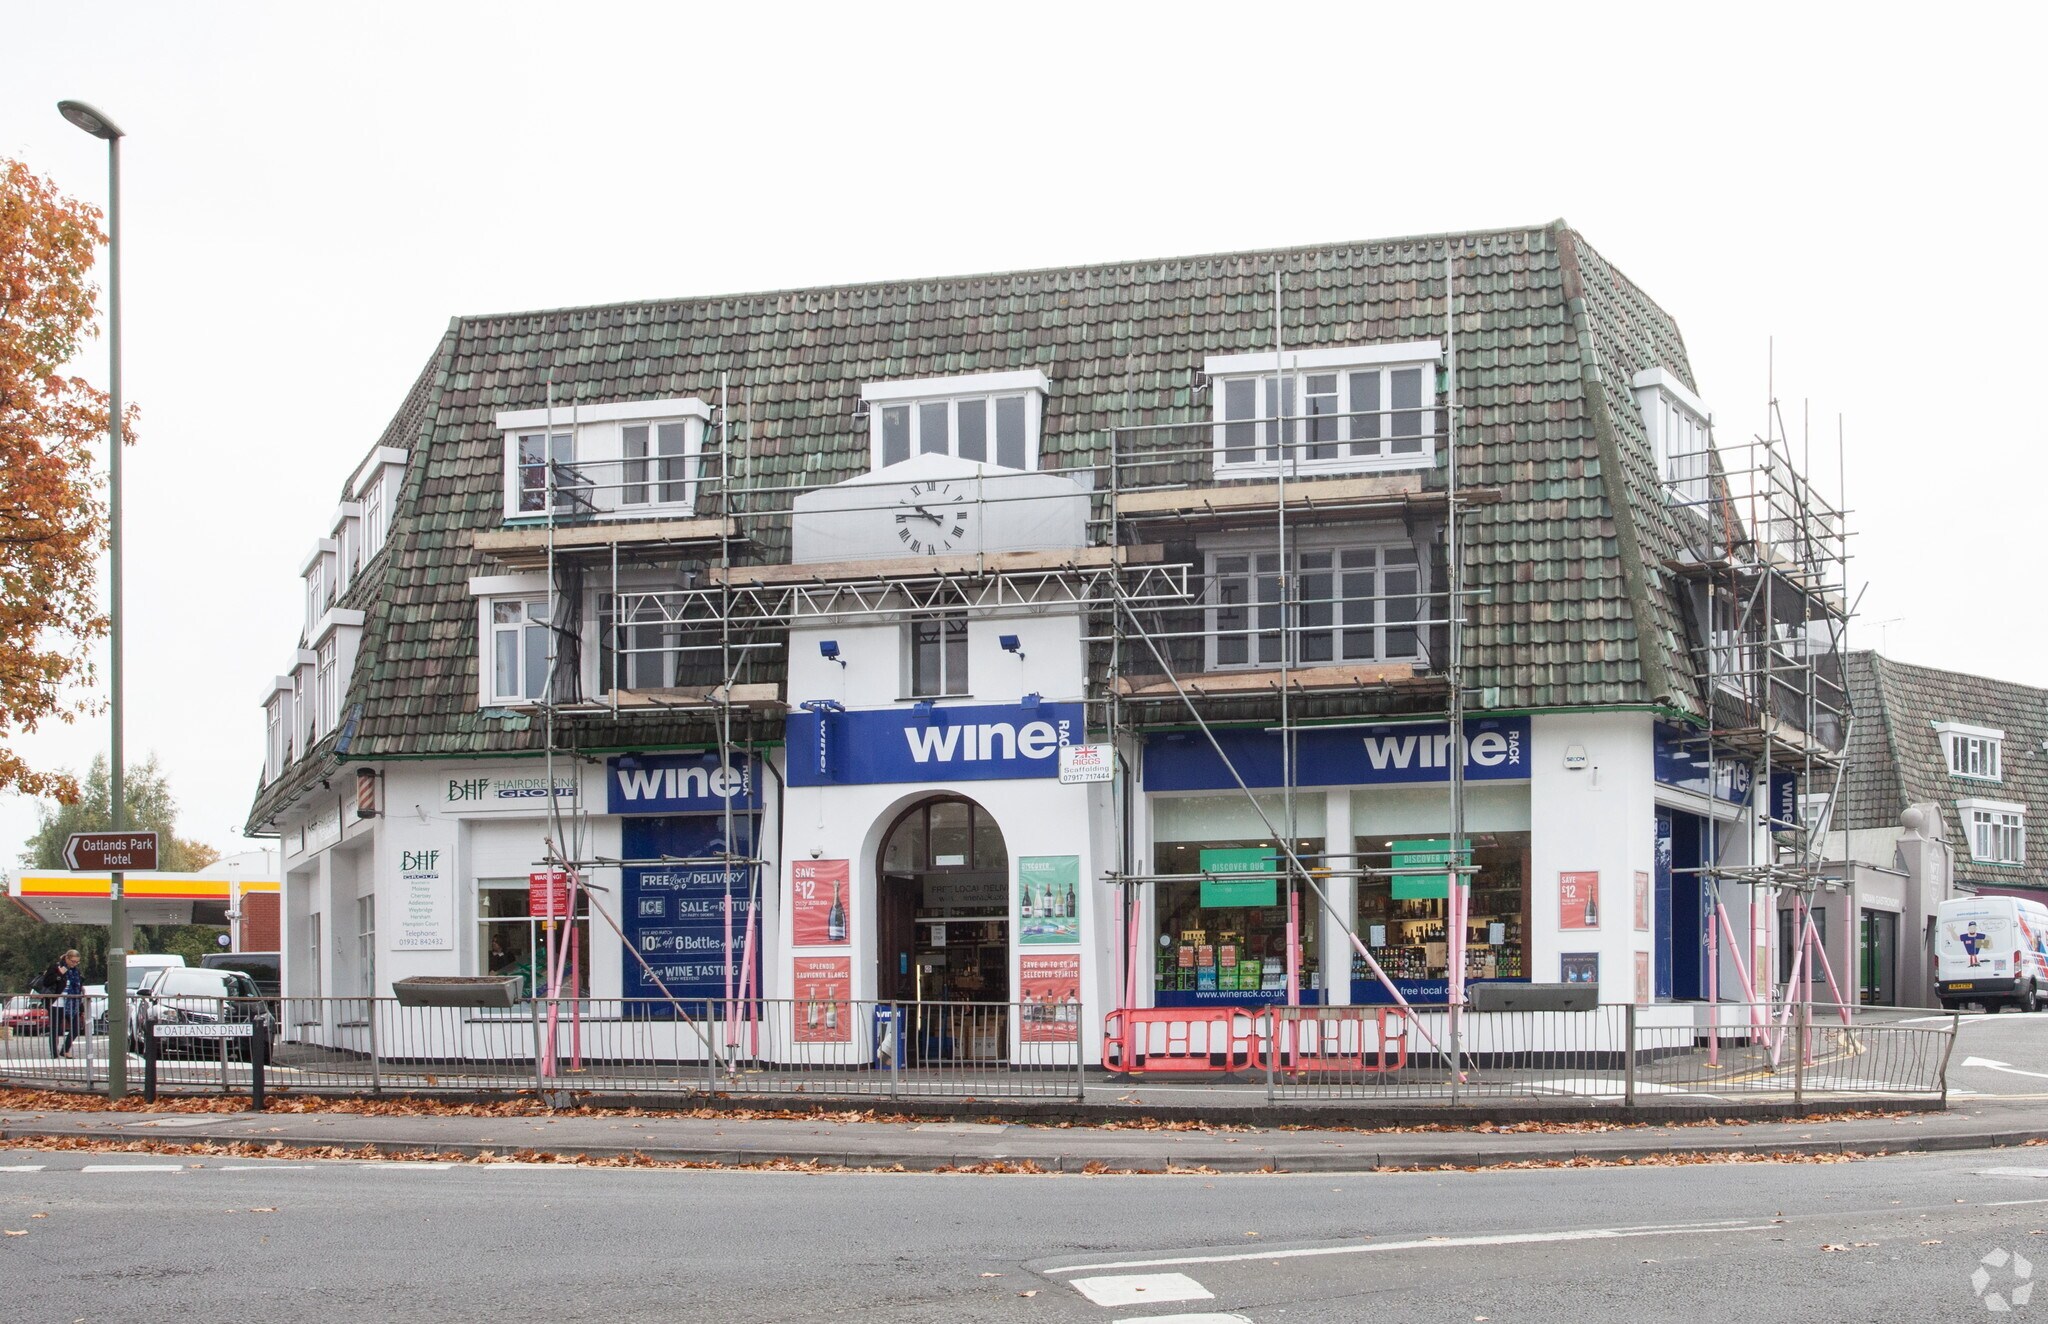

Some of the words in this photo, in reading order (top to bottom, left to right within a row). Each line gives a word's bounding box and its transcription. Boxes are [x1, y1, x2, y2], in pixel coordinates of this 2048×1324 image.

[1058, 720, 1070, 747] RAC
[904, 720, 1057, 763] wine
[1509, 730, 1519, 765] RACK
[1363, 731, 1508, 770] wine
[1072, 758, 1101, 766] RIGGS
[1064, 765, 1110, 774] Scaffolding
[617, 766, 742, 800] wine
[447, 777, 491, 803] BHF
[1782, 780, 1794, 824] wine
[82, 839, 127, 852] Oatlands
[130, 838, 153, 850] Park
[103, 852, 132, 865] Hotel
[401, 848, 440, 872] BHF
[1404, 854, 1440, 863] DISCOVER
[795, 867, 816, 878] SAVE
[1212, 862, 1247, 872] DISCOVER
[1250, 862, 1265, 871] OUR
[642, 874, 669, 886] FREE
[1561, 876, 1576, 884] SAVE
[795, 880, 816, 899] £12
[1561, 885, 1576, 898] £12
[640, 900, 663, 915] ICE
[681, 901, 709, 913] SALE
[718, 901, 761, 912] RTURN
[675, 935, 684, 950] 6
[685, 935, 720, 950] Bottles
[1069, 960, 1078, 968] ON
[665, 965, 693, 977] WINE
[1054, 970, 1078, 978] SPIRITS
[1196, 989, 1285, 998] www.winerack.co.uk
[1400, 986, 1418, 995] free
[1420, 986, 1442, 995] local
[164, 1025, 217, 1036] OATLANDS
[220, 1025, 252, 1035] DRIVE
